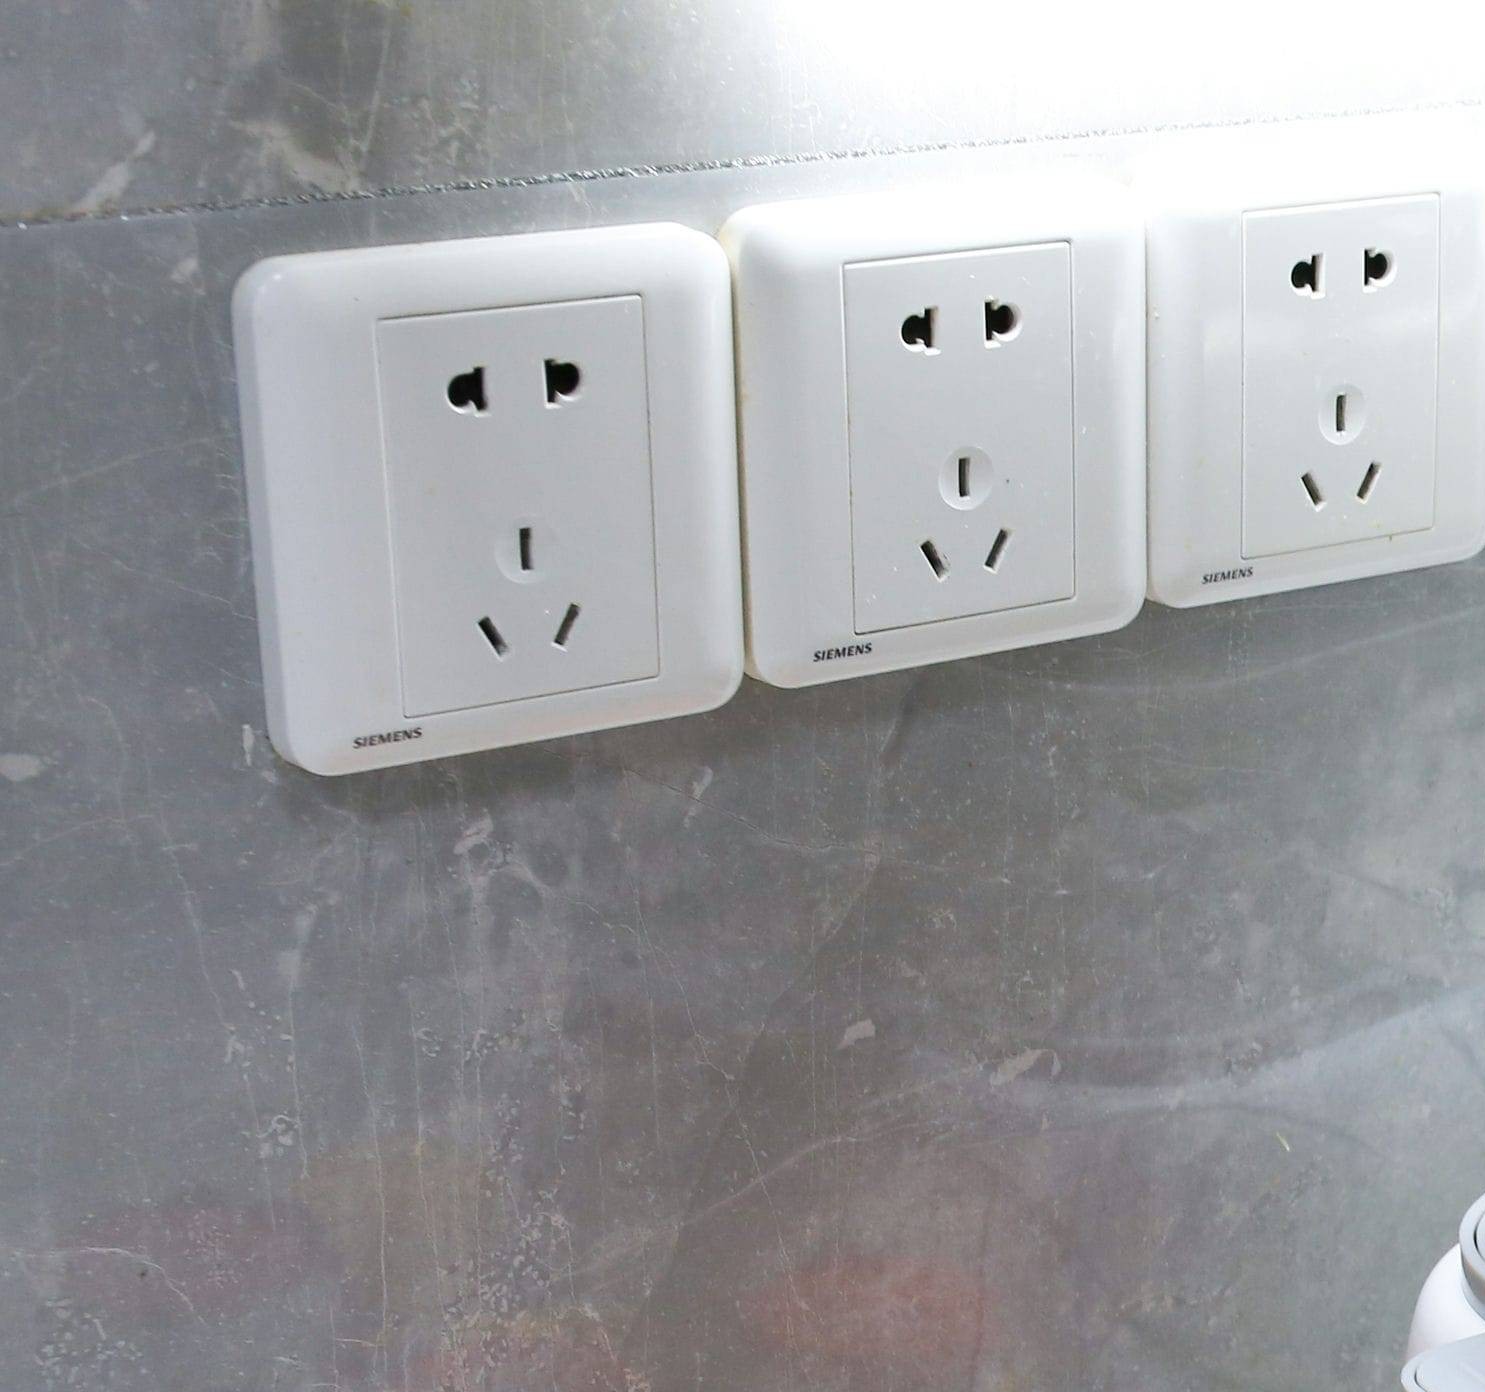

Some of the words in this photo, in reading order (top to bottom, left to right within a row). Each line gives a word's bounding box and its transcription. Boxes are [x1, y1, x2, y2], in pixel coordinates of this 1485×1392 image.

[1201, 566, 1253, 585] SIEMENS
[812, 642, 873, 662] SIEMENS
[352, 727, 423, 749] SIEMENS
